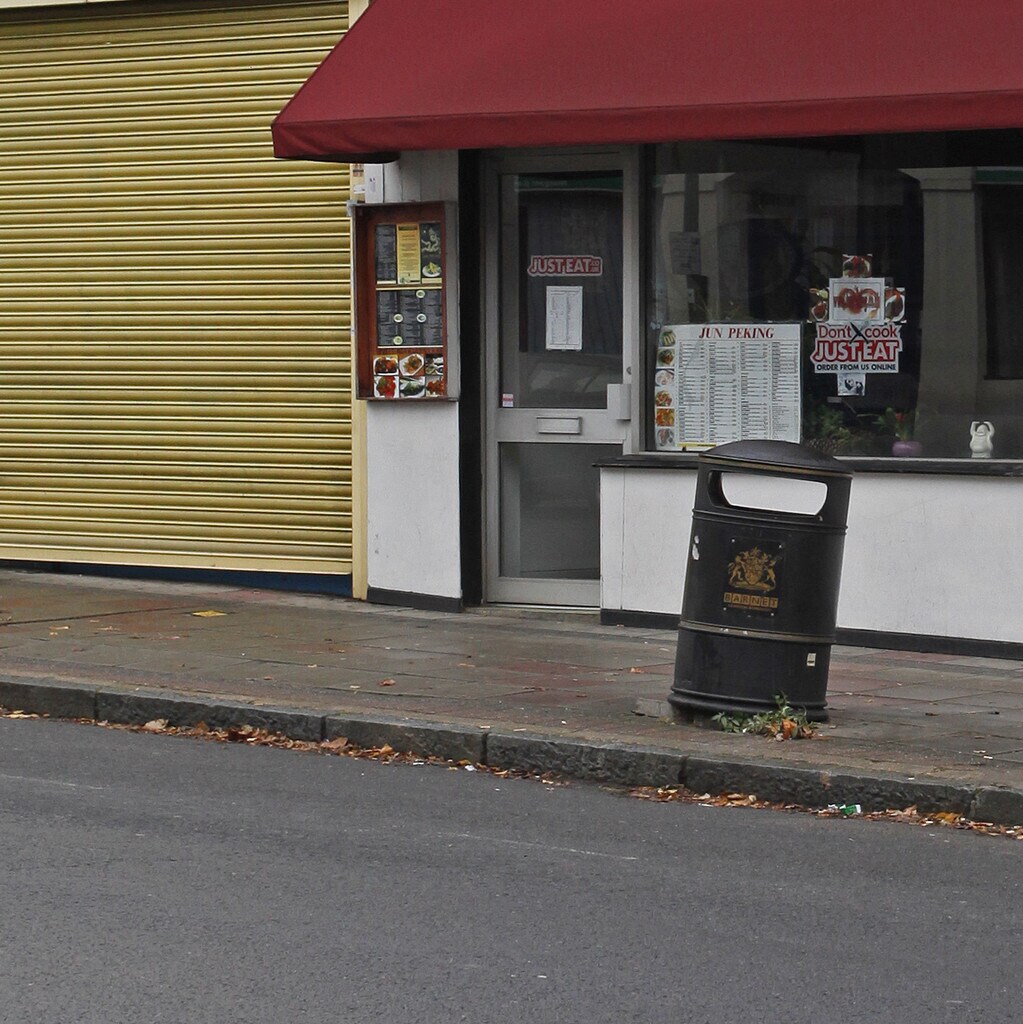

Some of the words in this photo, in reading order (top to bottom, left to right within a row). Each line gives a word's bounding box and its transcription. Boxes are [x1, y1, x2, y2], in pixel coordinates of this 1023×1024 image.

[699, 327, 723, 338] JUN
[728, 327, 774, 338] PEKING
[819, 325, 852, 338] Don't
[865, 324, 897, 338] cook
[816, 363, 838, 371] ORDER
[840, 363, 859, 371] FROM
[861, 363, 869, 371] US
[871, 363, 896, 371] ONLINE
[724, 593, 778, 608] BARNET
